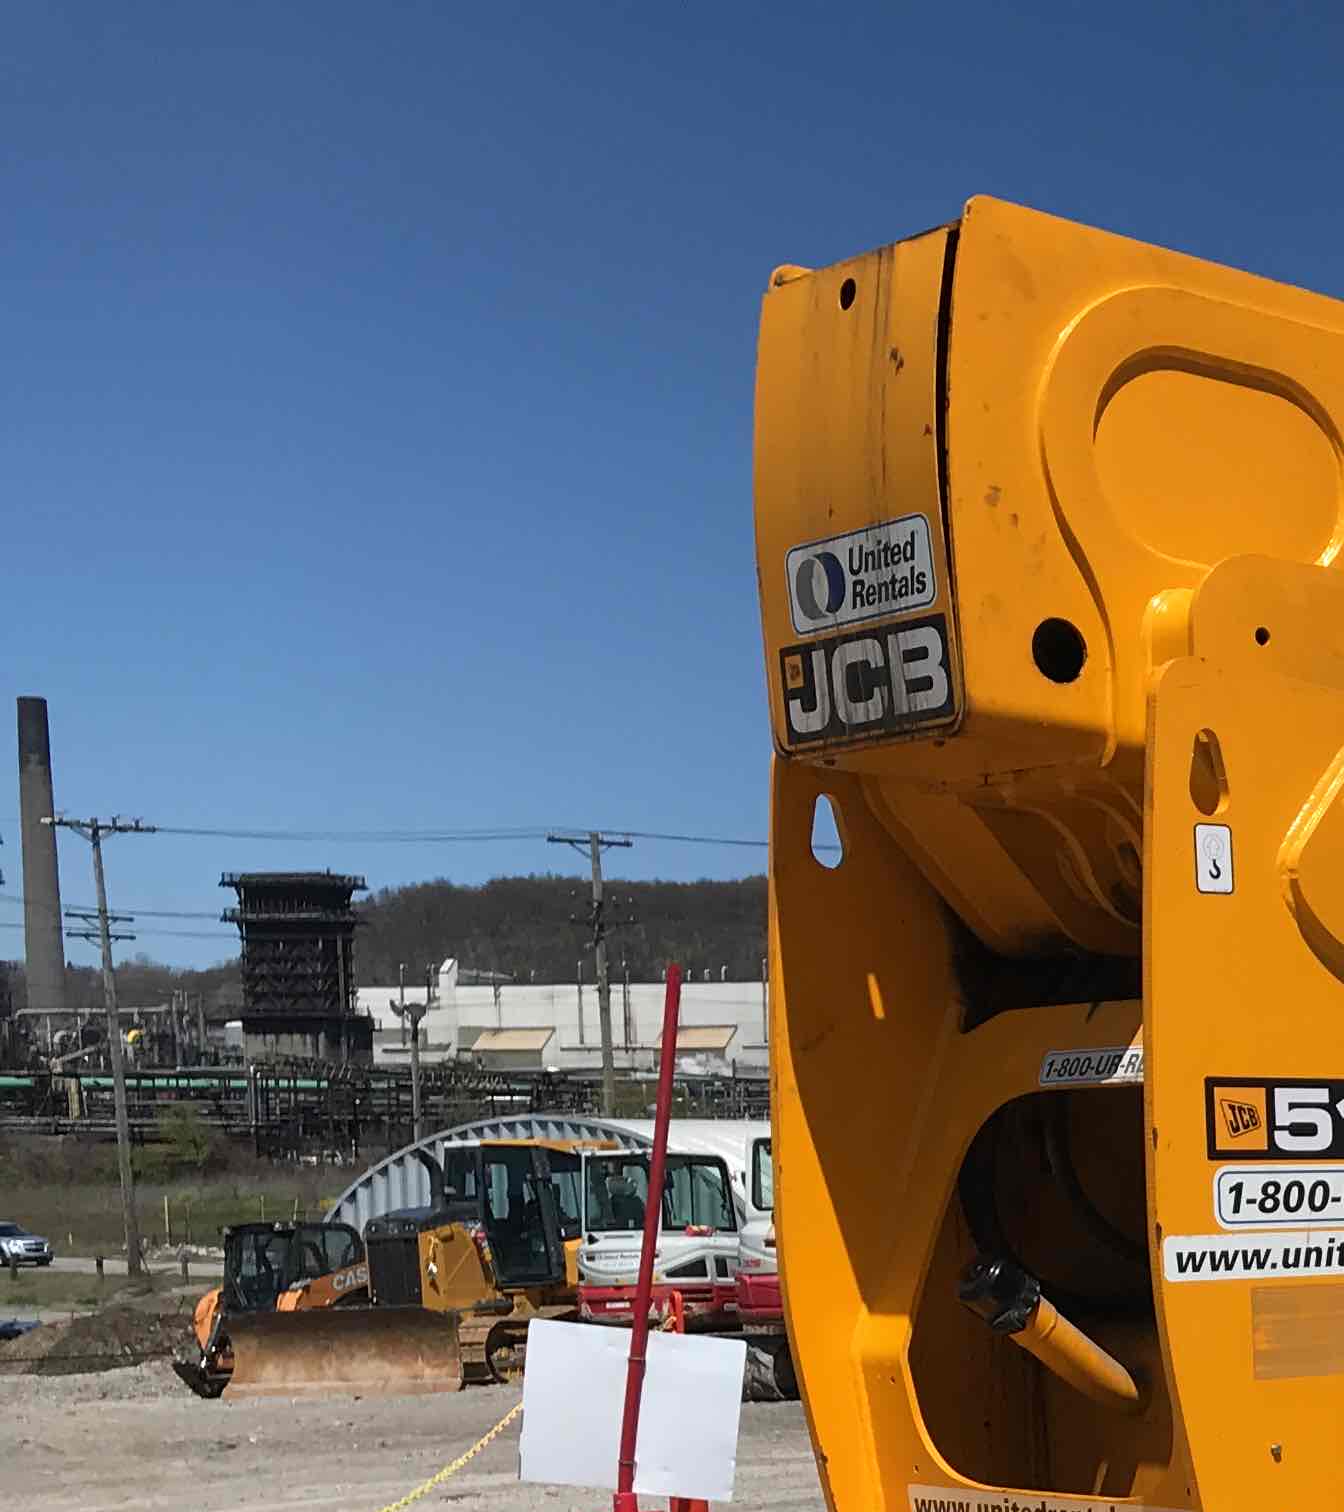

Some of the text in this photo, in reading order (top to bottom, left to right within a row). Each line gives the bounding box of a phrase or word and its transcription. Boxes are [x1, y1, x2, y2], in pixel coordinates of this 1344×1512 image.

[849, 530, 916, 576] United
[851, 565, 927, 609] Rentals
[788, 625, 949, 733] JCB
[1226, 1102, 1258, 1134] JCB
